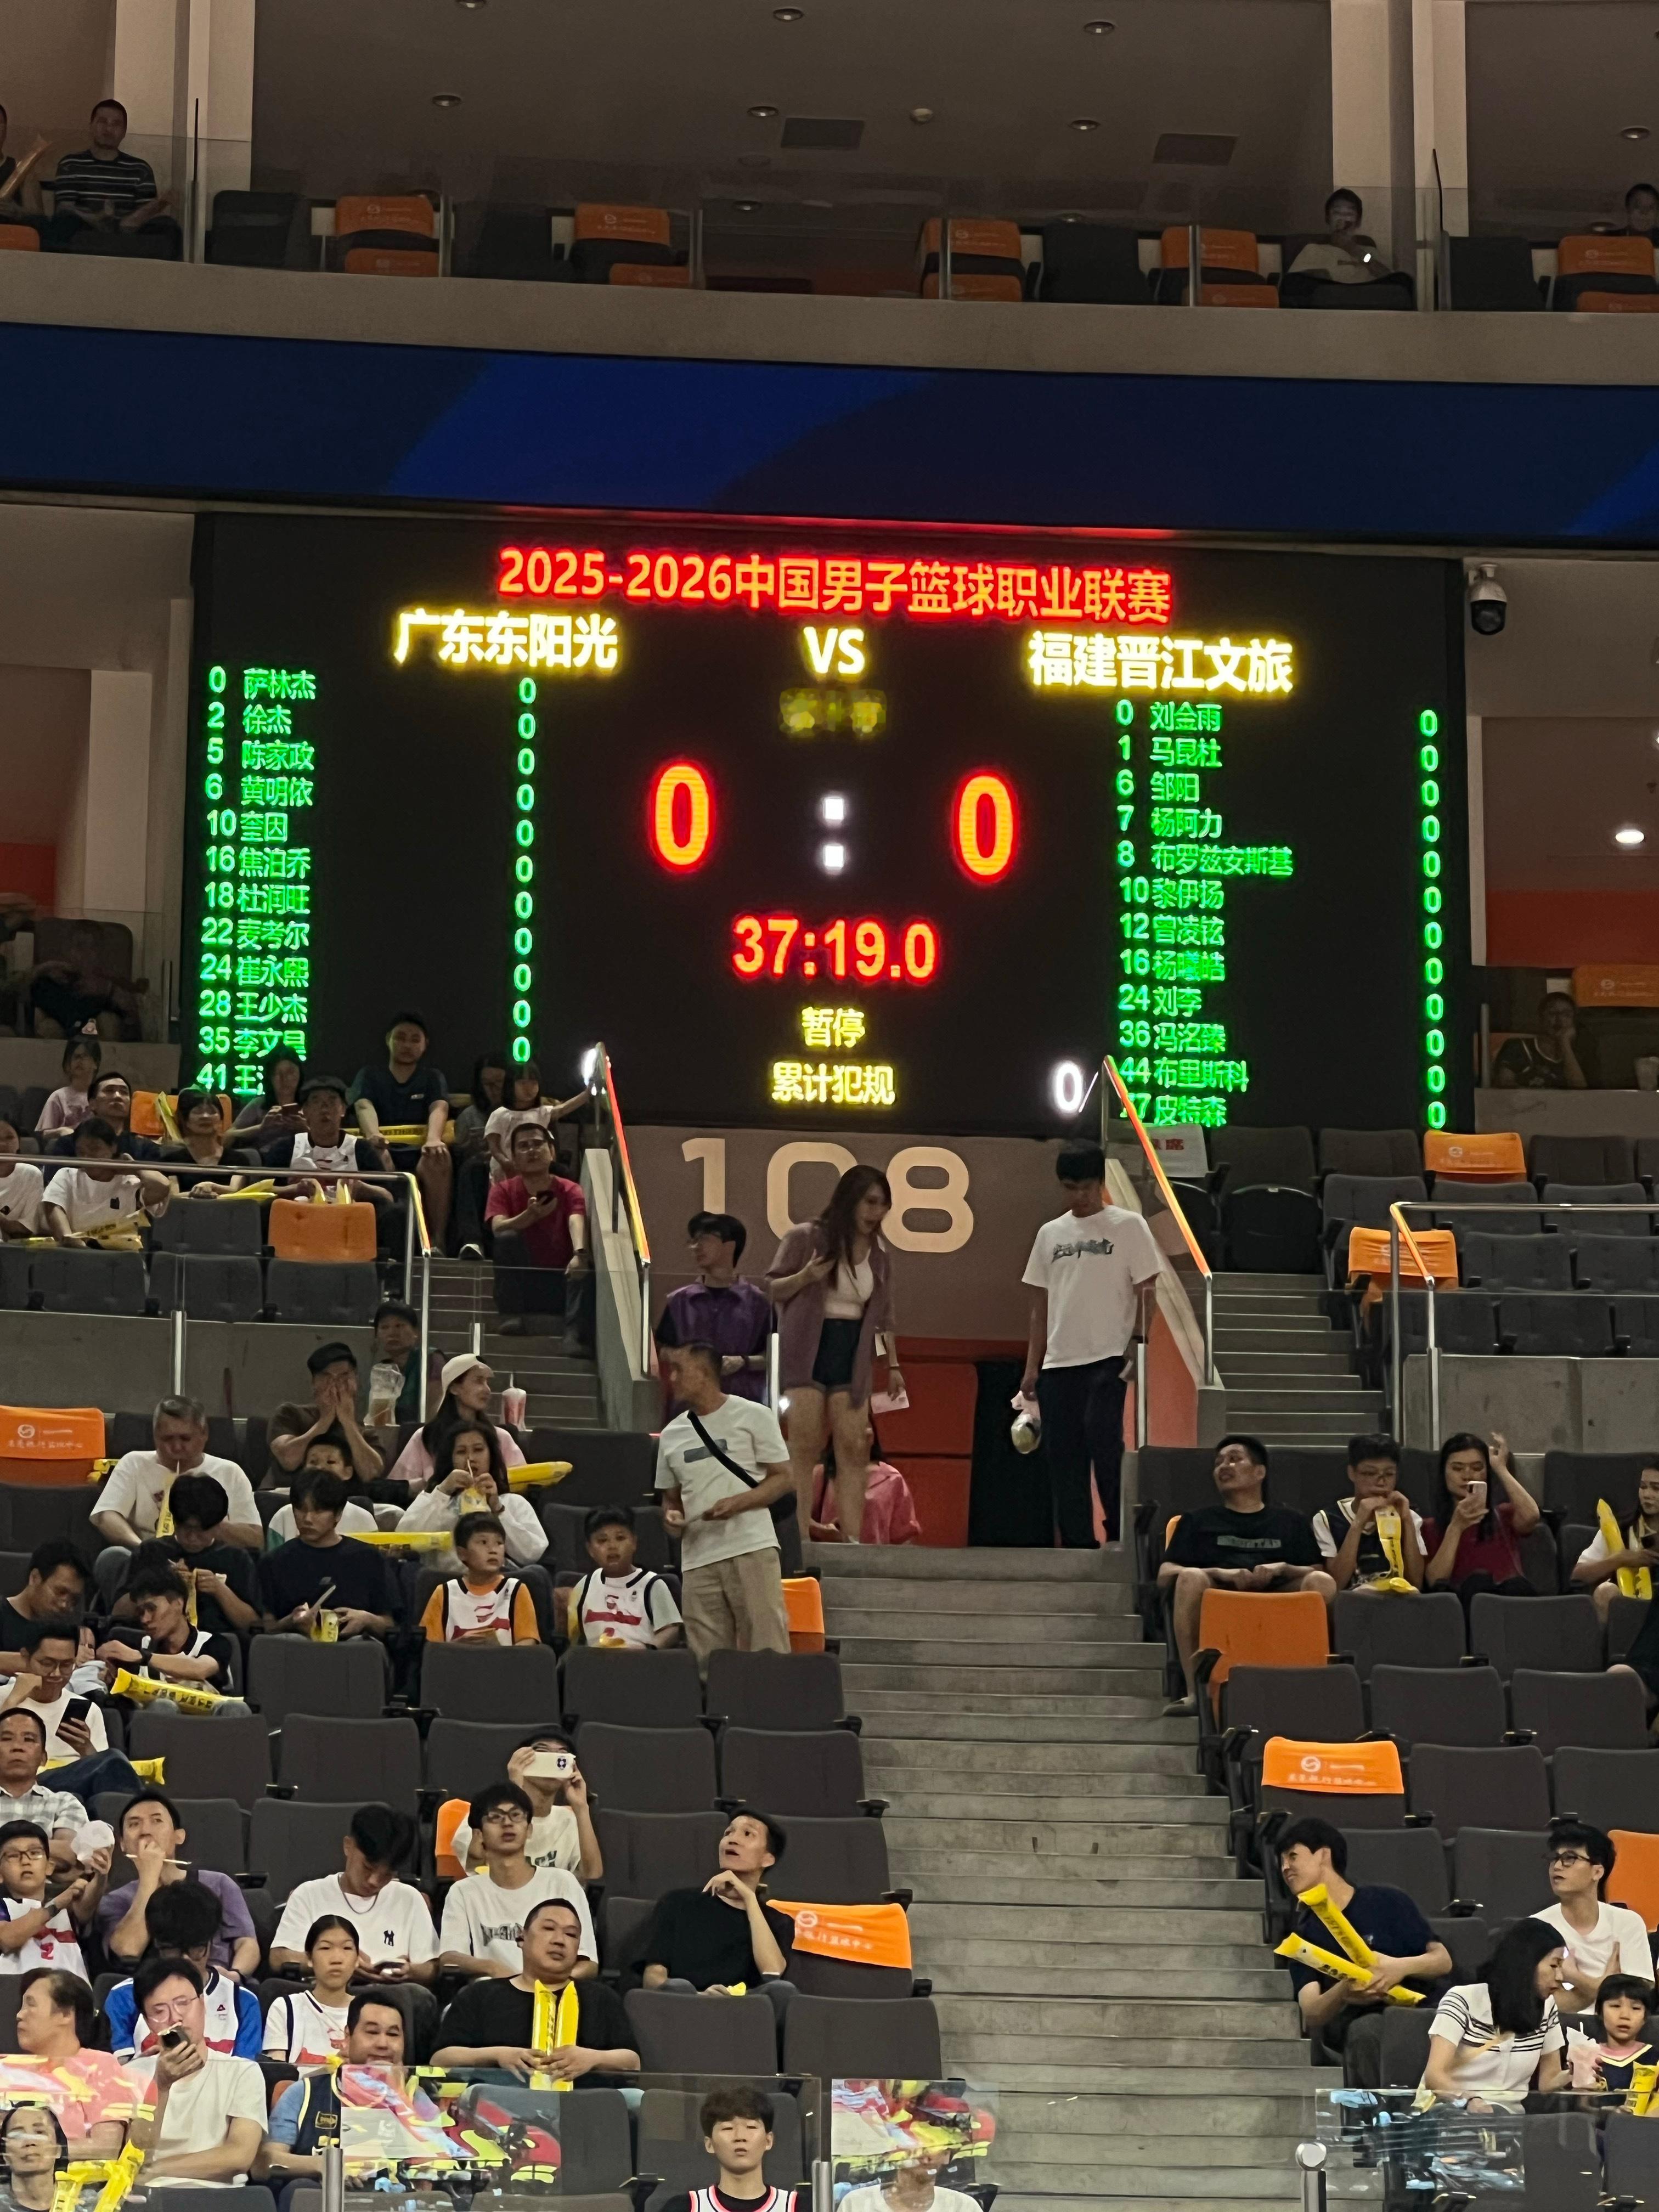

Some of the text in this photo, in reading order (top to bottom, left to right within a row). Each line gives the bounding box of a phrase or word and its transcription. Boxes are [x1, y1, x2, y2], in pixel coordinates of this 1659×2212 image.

[498, 549, 1171, 624] 2025-2026中国男子篮球职业联赛
[394, 608, 618, 670] 广东东阳光
[804, 627, 865, 674] VS
[1028, 631, 1293, 693] 福建晋江文旅
[209, 666, 536, 703] 0 萨林杰 0
[207, 702, 535, 739] 2 徐杰 0
[1116, 699, 1437, 737] 0 刘金雨 0
[207, 737, 534, 775] 5 陈家政 0
[1118, 735, 1130, 760] 1
[1421, 745, 1438, 771] 0
[205, 773, 534, 811] 6 黄明依 0
[1116, 769, 1439, 806] 6 邹阳 0
[207, 809, 534, 847] 10 奎因 0
[652, 763, 712, 868] 0
[956, 773, 1015, 878] 0
[1117, 805, 1440, 842] 7 杨阿力 0
[206, 845, 533, 883] 16 焦泊乔 0
[1118, 840, 1135, 867] 8
[1423, 851, 1440, 877] 0
[205, 882, 533, 919] 18 杜润旺 0
[1120, 876, 1441, 913] 10 黎伊扬 0
[201, 917, 532, 955] 22 麦考尔 0
[732, 915, 936, 979] 37:19.0
[1120, 912, 1149, 939] 12
[1425, 922, 1442, 949] 0
[200, 953, 531, 991] 24 崔永熙 0
[1120, 949, 1150, 975] 16
[1425, 957, 1443, 985] 0
[199, 989, 531, 1028] 28 王少杰 0
[1118, 984, 1150, 1011] 24
[1426, 994, 1443, 1021] 0
[199, 1026, 230, 1054] 35
[513, 1036, 530, 1062] 0
[802, 1007, 865, 1048] 暂停
[1120, 1020, 1150, 1047] 36
[1426, 1029, 1444, 1057] 0
[196, 1063, 226, 1091] 41
[772, 1061, 1083, 1113] 累计犯规 0
[1120, 1057, 1445, 1093] 44 布里斯科 0
[1154, 1094, 1227, 1127] 皮特森
[1428, 1102, 1446, 1128] 0
[682, 1138, 974, 1252] 108
